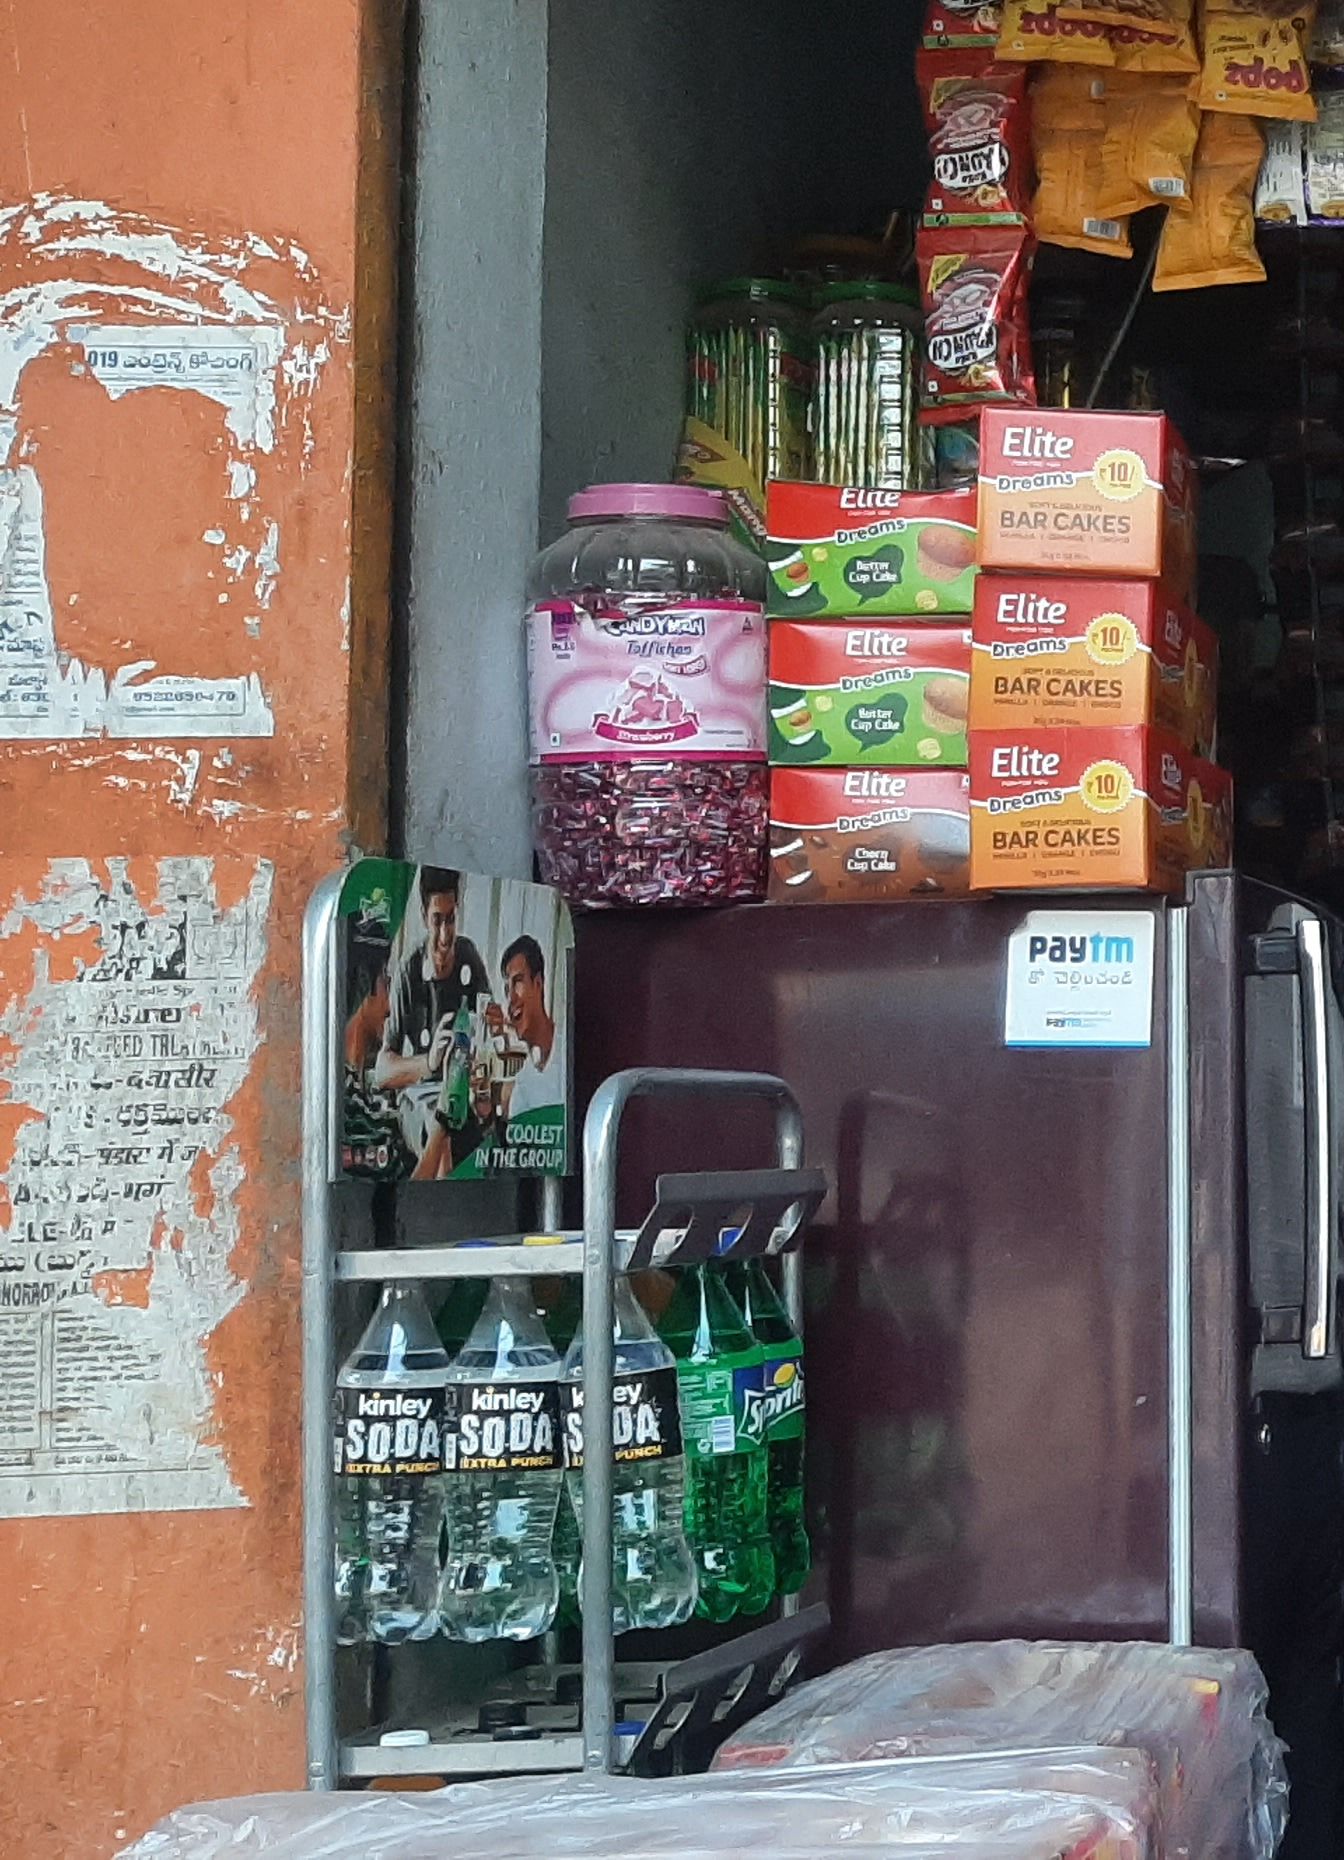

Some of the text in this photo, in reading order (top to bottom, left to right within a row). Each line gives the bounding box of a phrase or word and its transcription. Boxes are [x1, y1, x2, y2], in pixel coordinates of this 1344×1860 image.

[1002, 427, 1074, 459] Elite
[997, 472, 1074, 491] Dreams
[840, 488, 900, 509] Elite
[836, 518, 905, 544] Dreams
[1001, 510, 1131, 535] BAR CAKES
[996, 592, 1067, 625] Elite
[844, 630, 908, 657] Elite
[992, 638, 1067, 659] Dreams
[841, 668, 913, 692] Dreams
[994, 677, 1123, 699] BAR CAKES
[991, 745, 1060, 777] Elite
[844, 771, 906, 797] Elite
[989, 788, 1062, 812] Dreams
[837, 808, 910, 832] Dreams
[992, 827, 1121, 851] BAR CAKES
[1029, 931, 1134, 964] Paytm
[506, 1124, 563, 1145] COOLEST
[476, 1148, 563, 1169] IN THE GROUP
[358, 1392, 433, 1419] kinley
[472, 1385, 545, 1413] kinley
[459, 1411, 554, 1457] SODA
[567, 1403, 661, 1452] SDA
[346, 1418, 440, 1463] SODA
[615, 1444, 662, 1461] PUNCH
